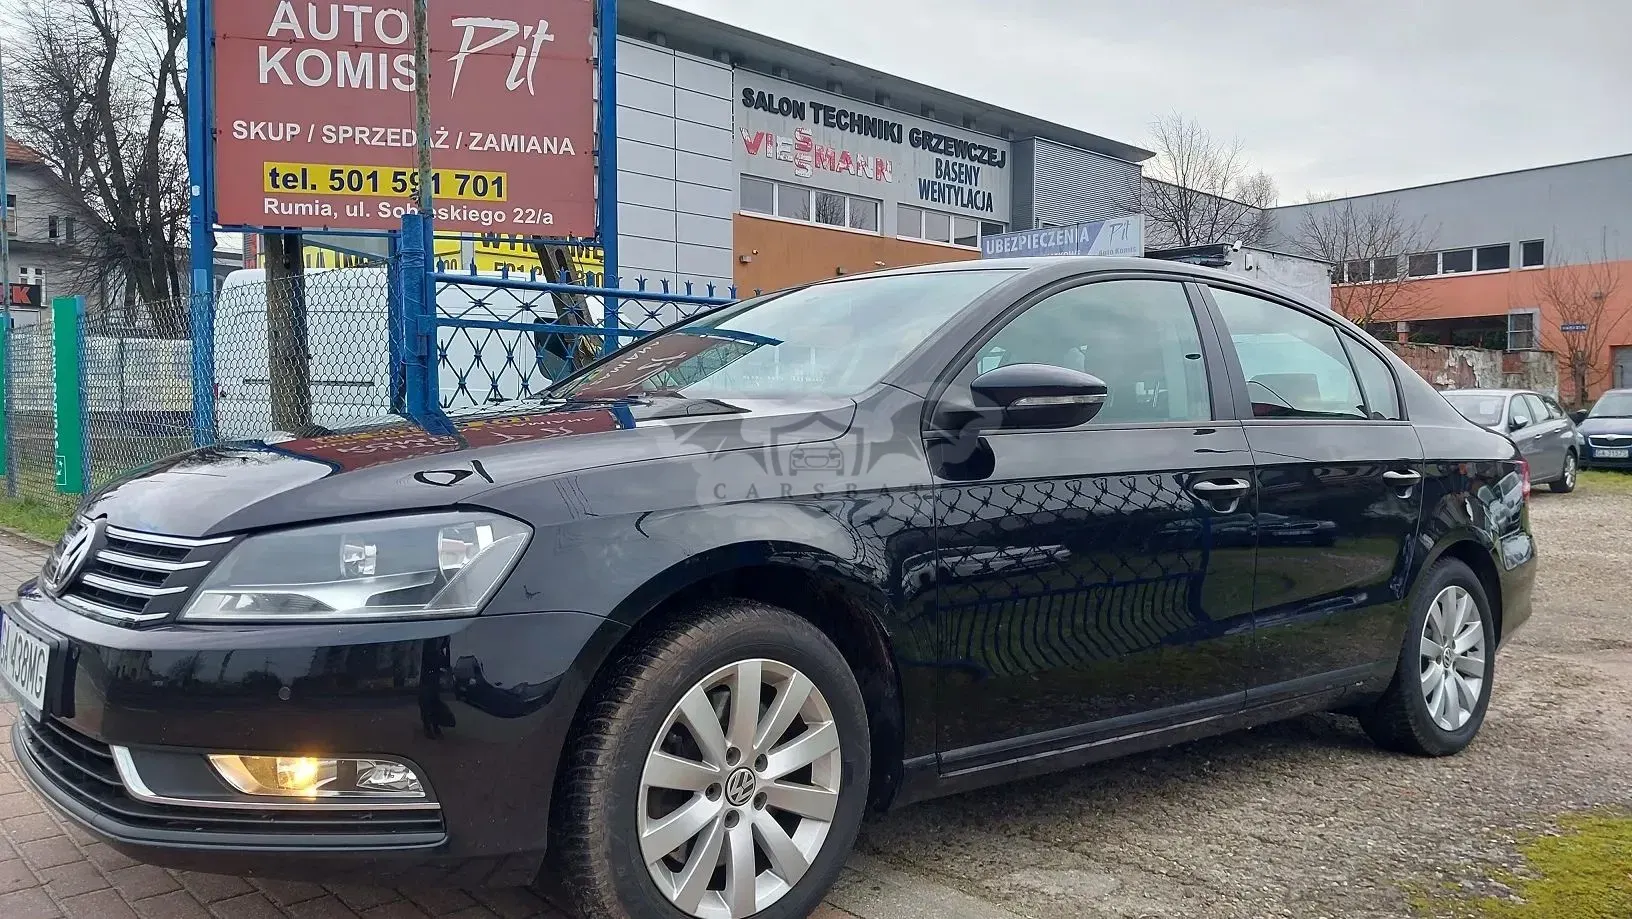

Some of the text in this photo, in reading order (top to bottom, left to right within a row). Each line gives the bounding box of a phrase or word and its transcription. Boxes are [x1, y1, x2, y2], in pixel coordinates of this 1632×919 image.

[267, 0, 410, 45] AUTO
[258, 45, 416, 92] KOMIS
[447, 17, 555, 100] Pit
[232, 120, 576, 156] SKUP / SPRZEDŻ / ZAMIANA
[742, 87, 1006, 168] SALON TECHNIKI GRZEWCZEJ
[269, 166, 317, 191] tel.
[328, 168, 378, 193] 501
[454, 173, 504, 198] 701
[935, 157, 981, 187] BASENY
[264, 197, 338, 219] Rumia,
[346, 201, 370, 218] ul.
[512, 207, 554, 225] 22/a
[918, 178, 994, 213] WENTYLACJA
[986, 226, 1090, 255] UBEZPIECZENIA
[1109, 219, 1132, 247] Pit
[11, 631, 46, 699] 438MG
